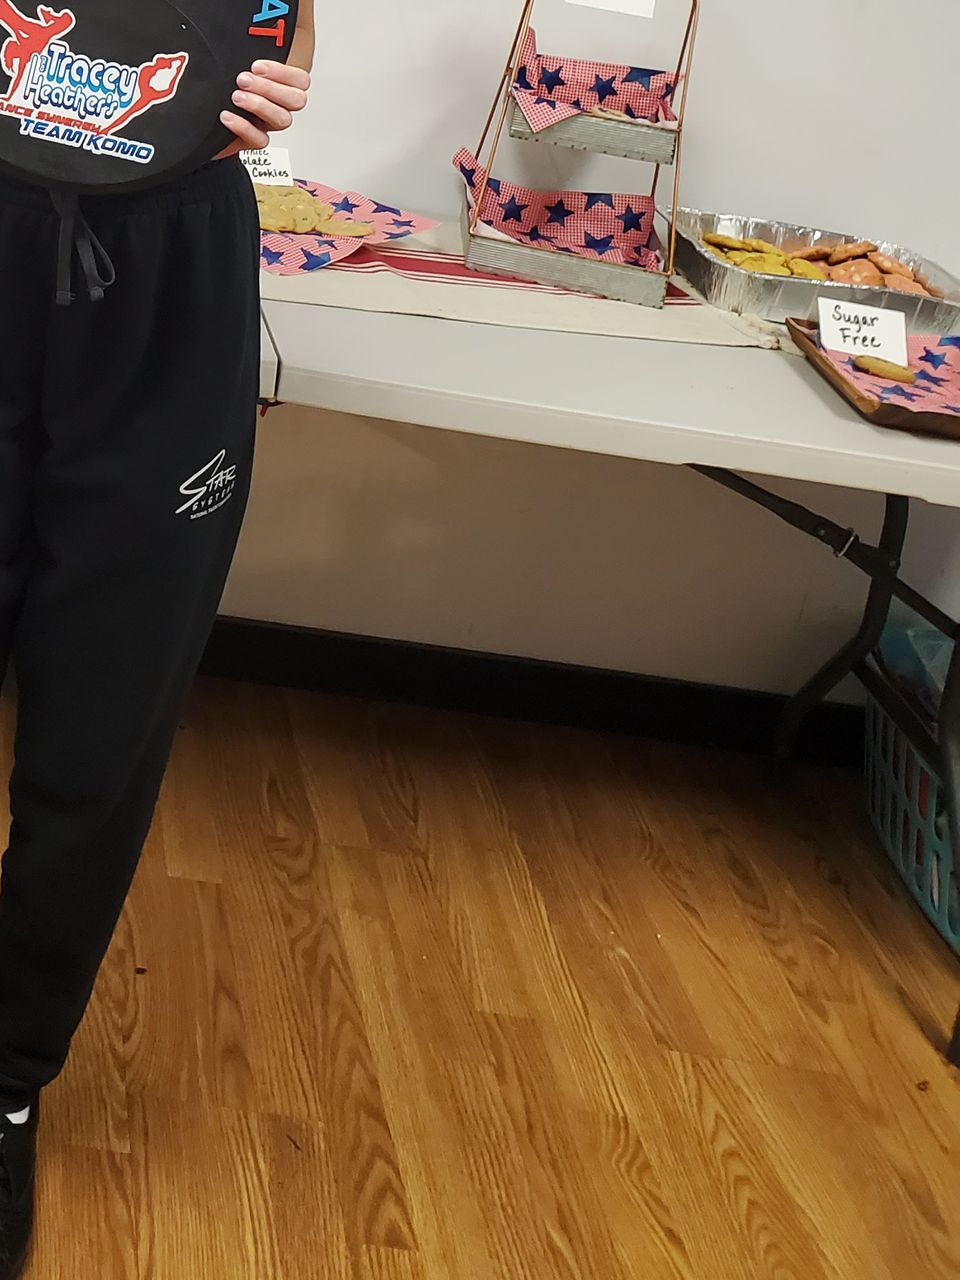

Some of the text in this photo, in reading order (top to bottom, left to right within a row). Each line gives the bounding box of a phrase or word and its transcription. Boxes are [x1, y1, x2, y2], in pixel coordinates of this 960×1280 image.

[24, 54, 118, 118] Heather's
[48, 43, 138, 108] Tracey
[35, 111, 102, 133] SYNERGY
[22, 118, 153, 160] TEAM KOMO
[252, 166, 289, 178] Cookies
[832, 304, 879, 333] Sugar
[839, 327, 881, 348] Free
